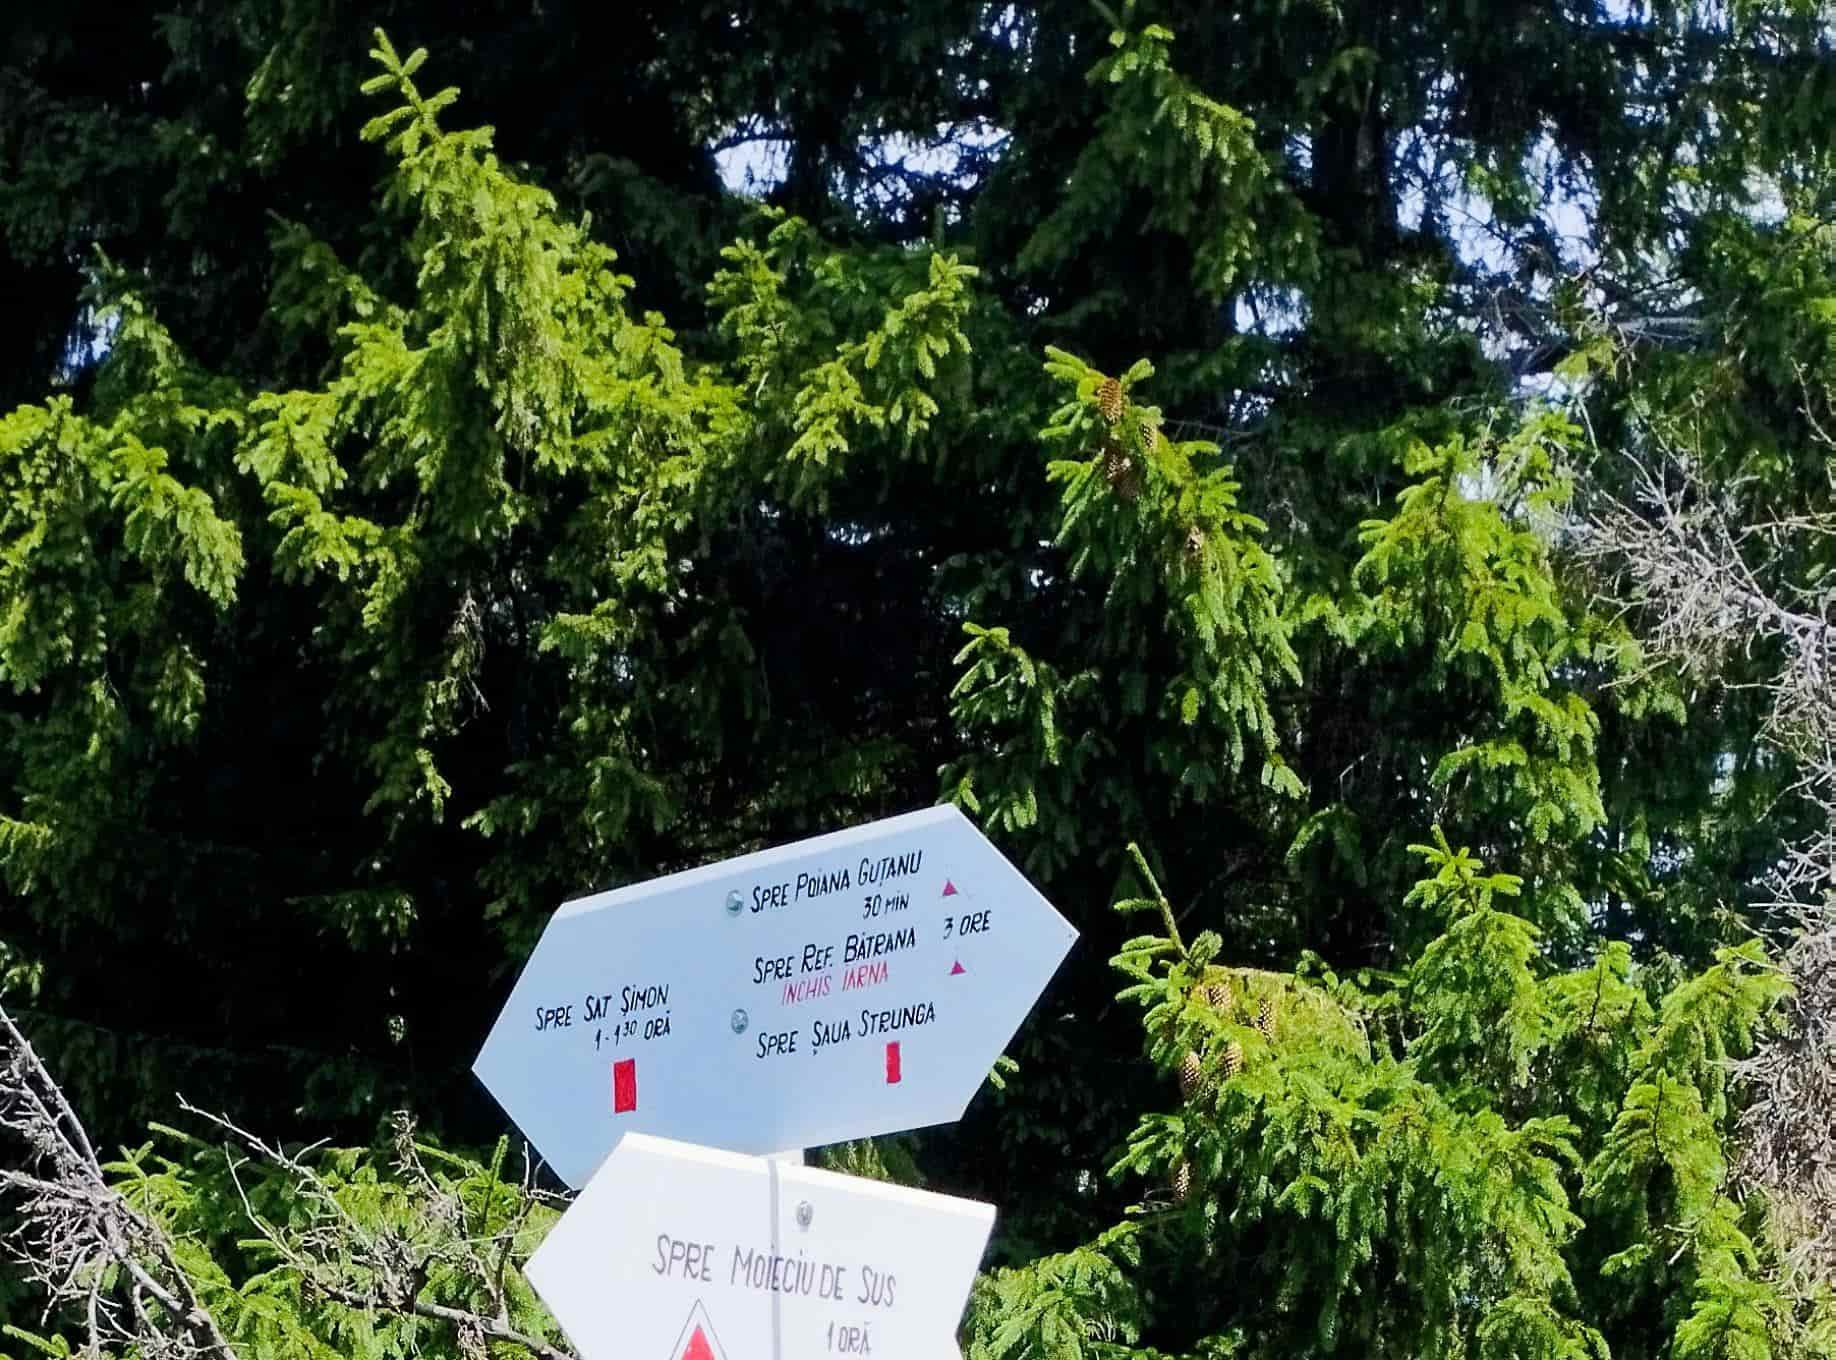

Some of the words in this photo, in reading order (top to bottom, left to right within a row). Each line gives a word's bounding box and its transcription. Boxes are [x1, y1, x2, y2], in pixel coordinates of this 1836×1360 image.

[751, 882, 790, 914] SPRE
[863, 895, 881, 919] 30
[943, 917, 954, 940] 3
[960, 910, 993, 937] ORE
[753, 956, 794, 984] SPRE
[800, 943, 834, 972] REF.
[536, 1005, 573, 1031] SPRE
[583, 994, 613, 1022] SAT
[756, 1030, 799, 1059] SPRE
[857, 1000, 936, 1037] STRUNGA
[651, 1233, 716, 1283] SPRE
[818, 1263, 847, 1301] DE
[856, 1264, 897, 1308] SUS
[826, 1319, 835, 1353] 1
